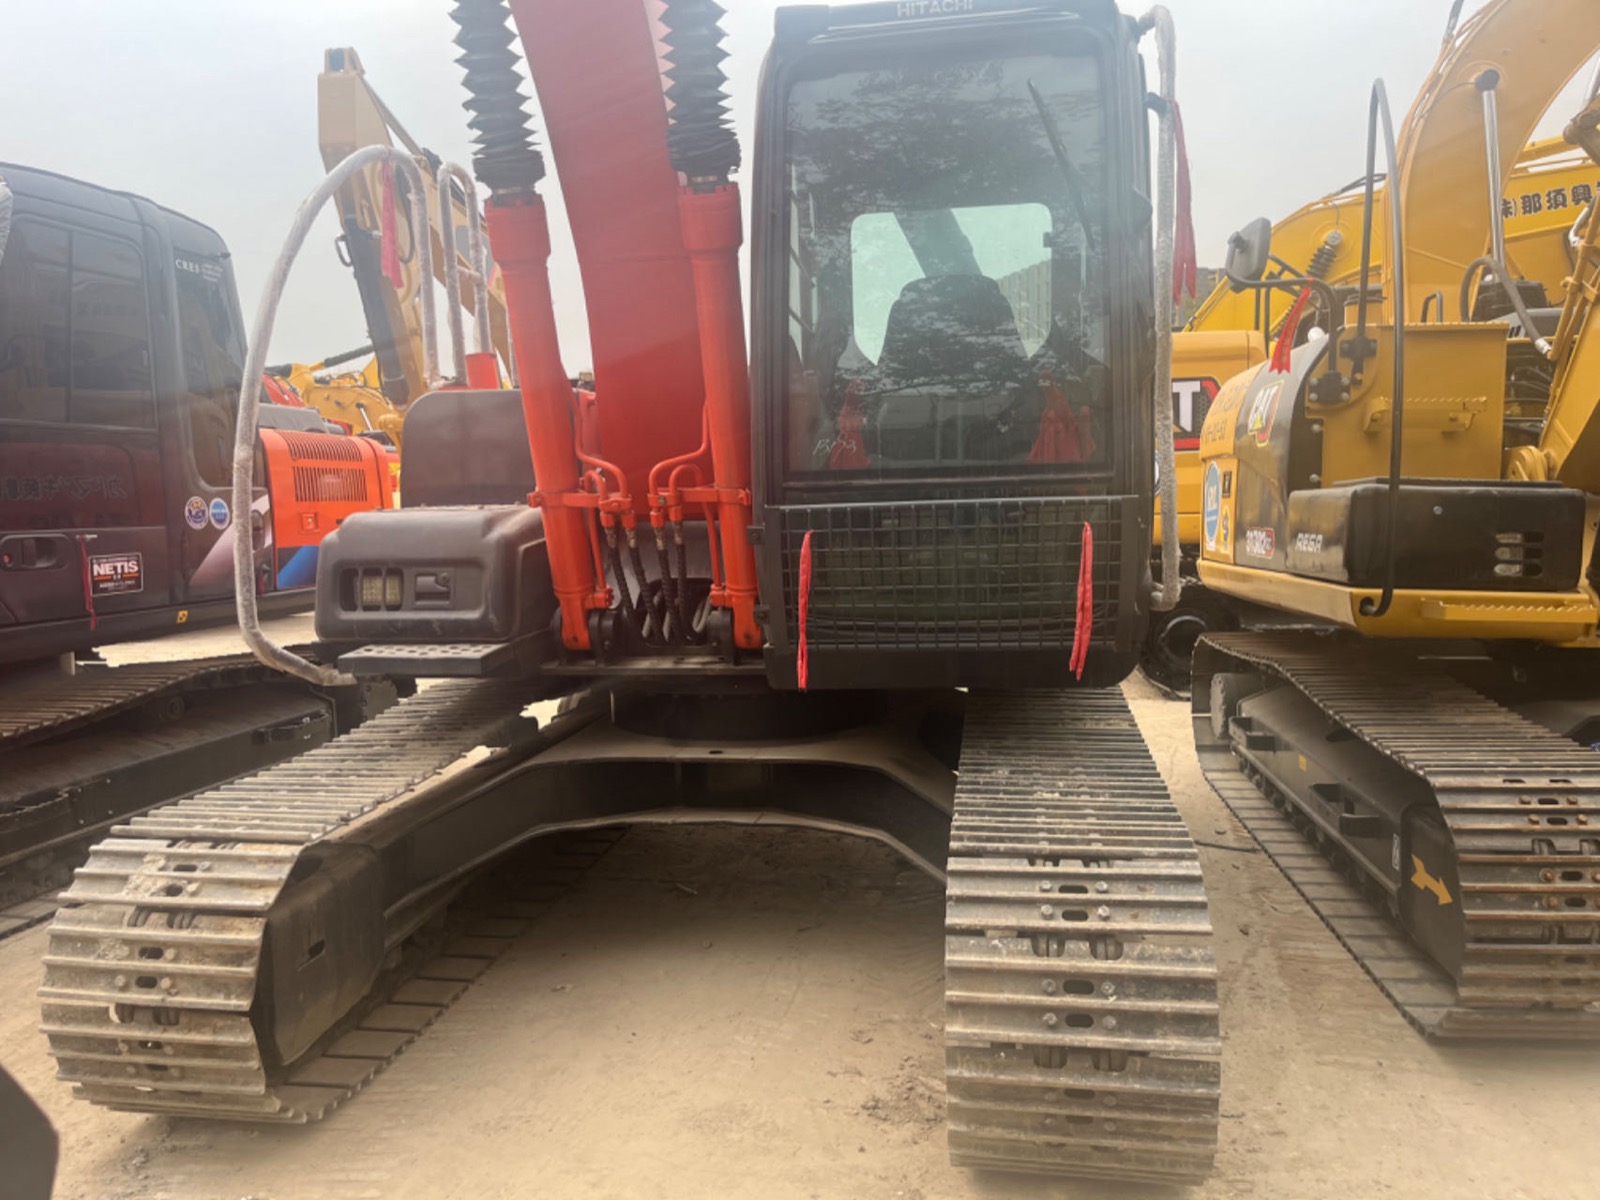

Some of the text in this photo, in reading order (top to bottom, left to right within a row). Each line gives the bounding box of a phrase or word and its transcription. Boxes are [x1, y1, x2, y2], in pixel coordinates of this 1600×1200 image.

[897, 0, 973, 17] HITACHI
[1248, 384, 1279, 433] CAT
[92, 560, 139, 576] NETIS
